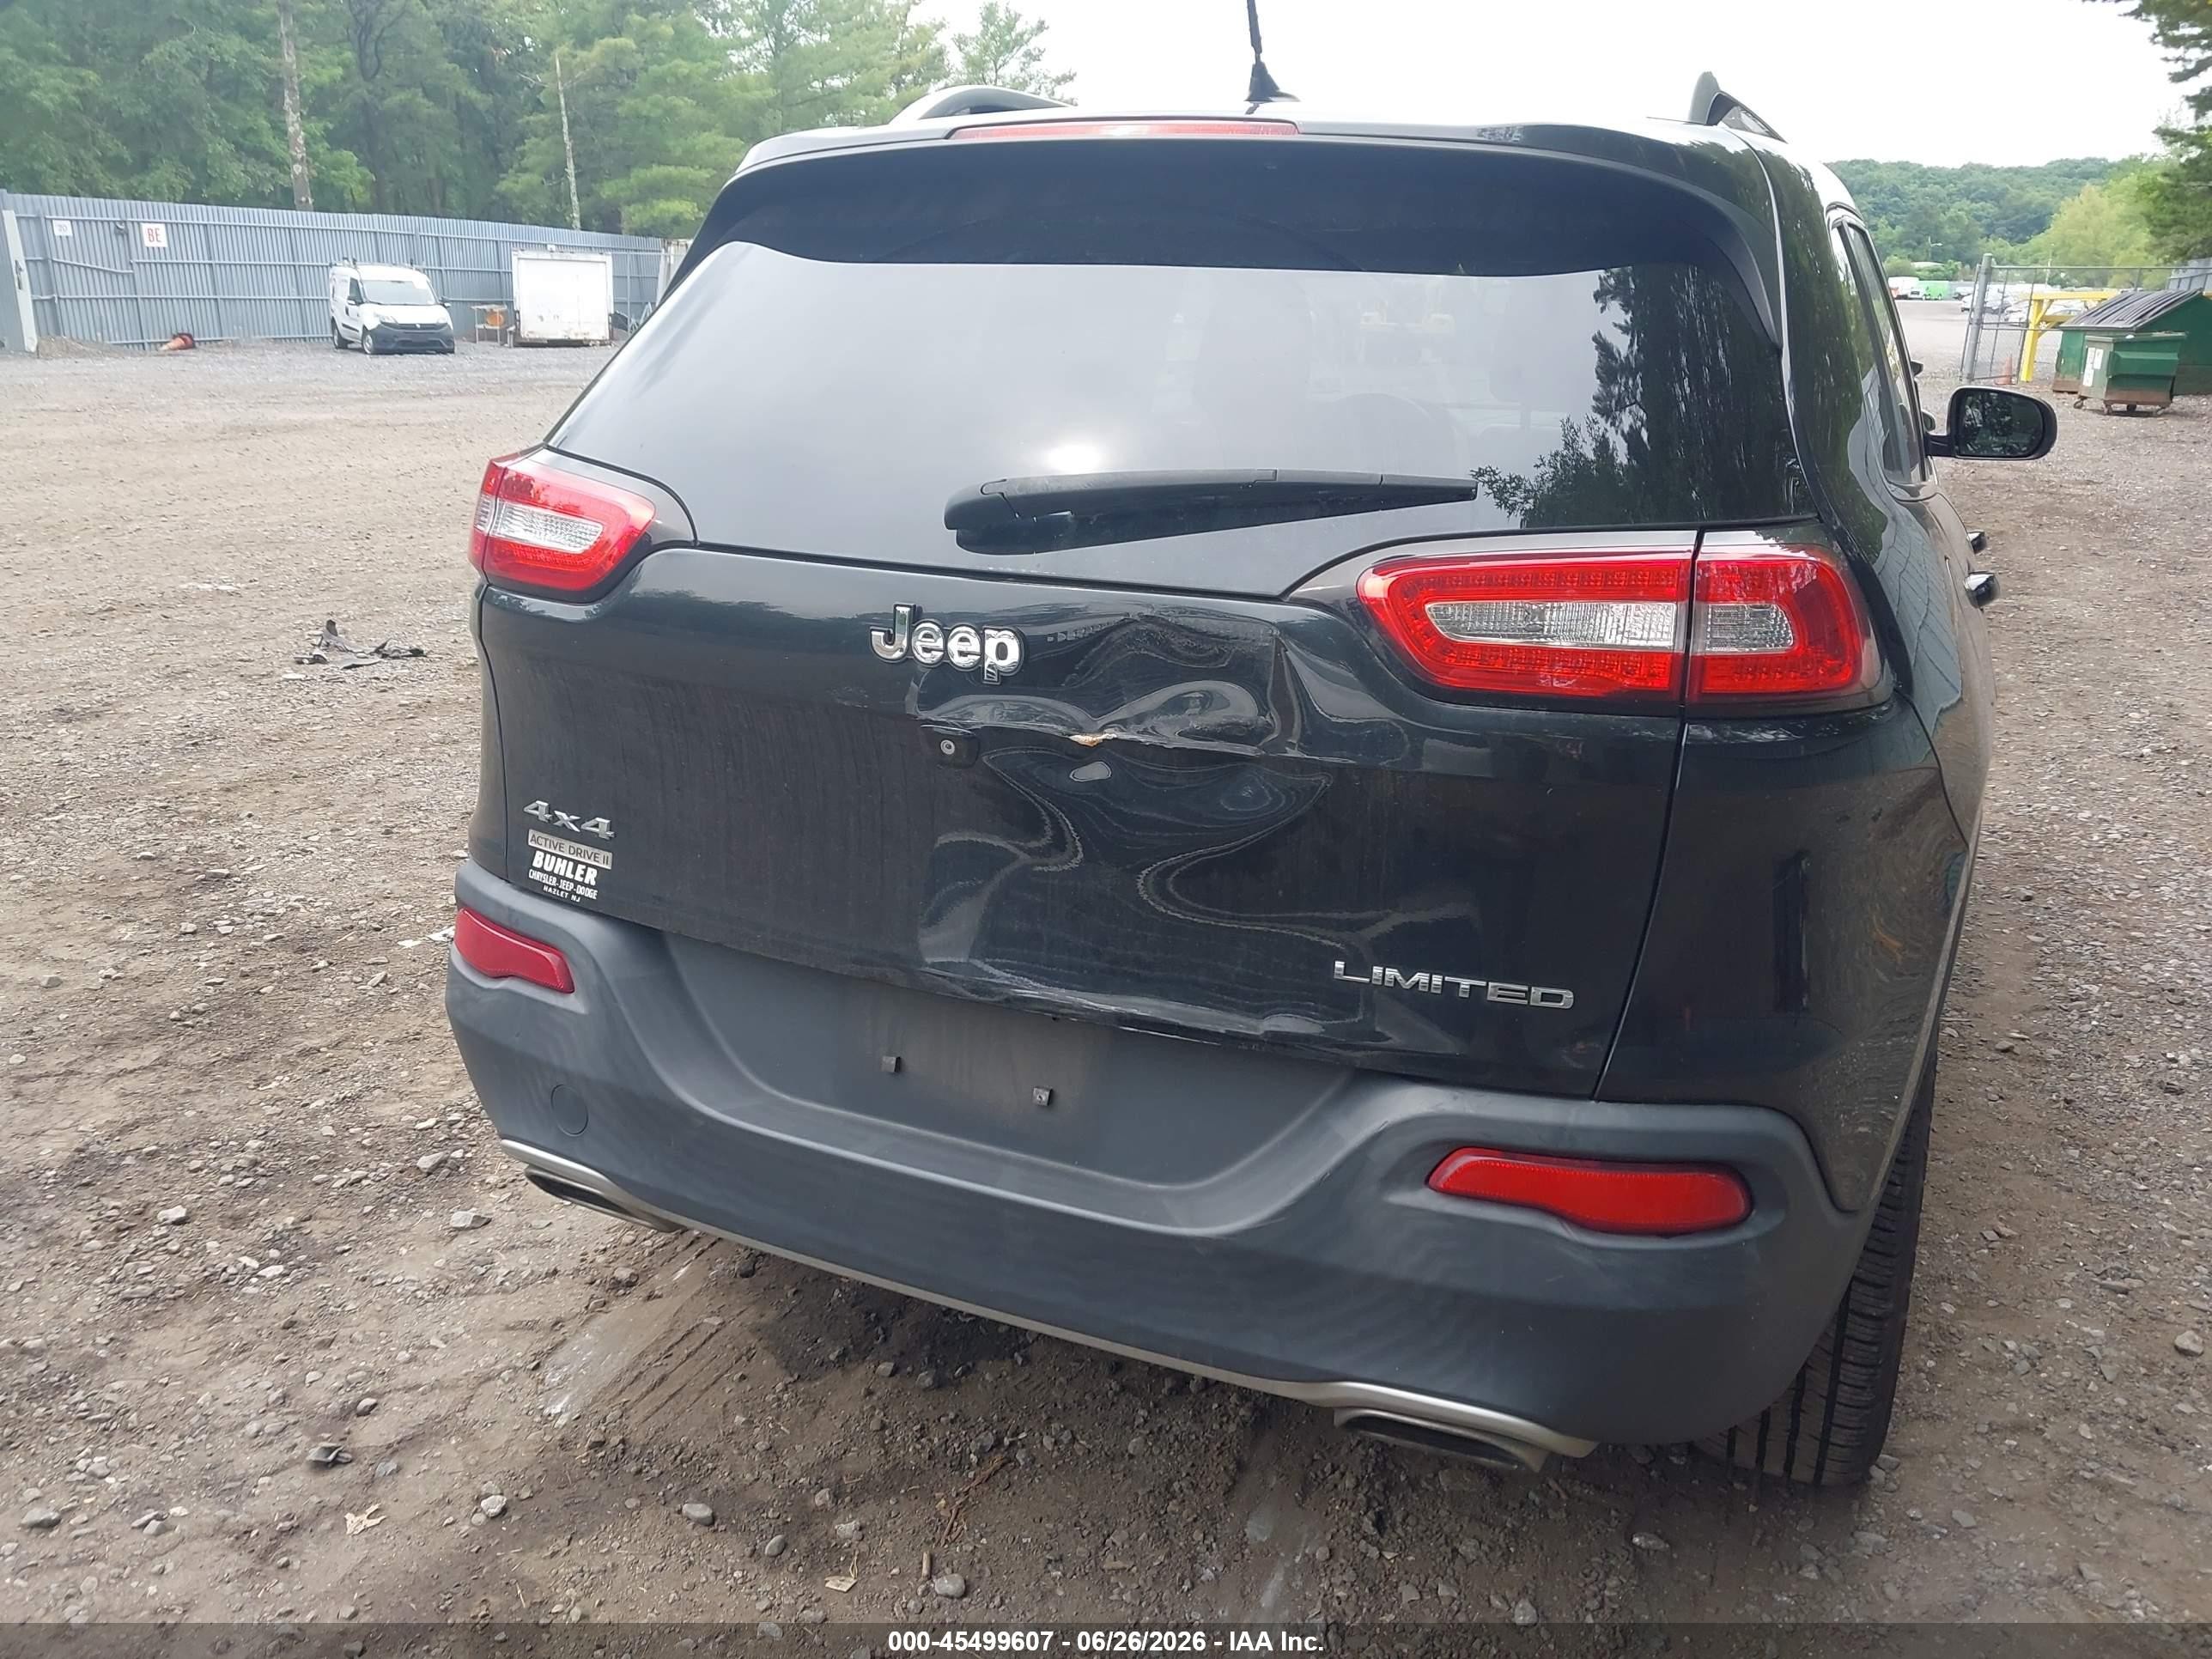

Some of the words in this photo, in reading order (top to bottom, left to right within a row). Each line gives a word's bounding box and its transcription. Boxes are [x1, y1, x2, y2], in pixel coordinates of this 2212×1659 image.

[147, 228, 162, 243] BE
[870, 603, 1024, 685] Jeep
[530, 834, 566, 853] ACTIVE
[568, 846, 601, 864] DRIVE
[602, 854, 610, 866] II
[532, 850, 599, 886] BUHLER
[543, 885, 569, 899] HAZLET
[570, 894, 581, 902] NJ
[1334, 960, 1575, 1010] LIMITED
